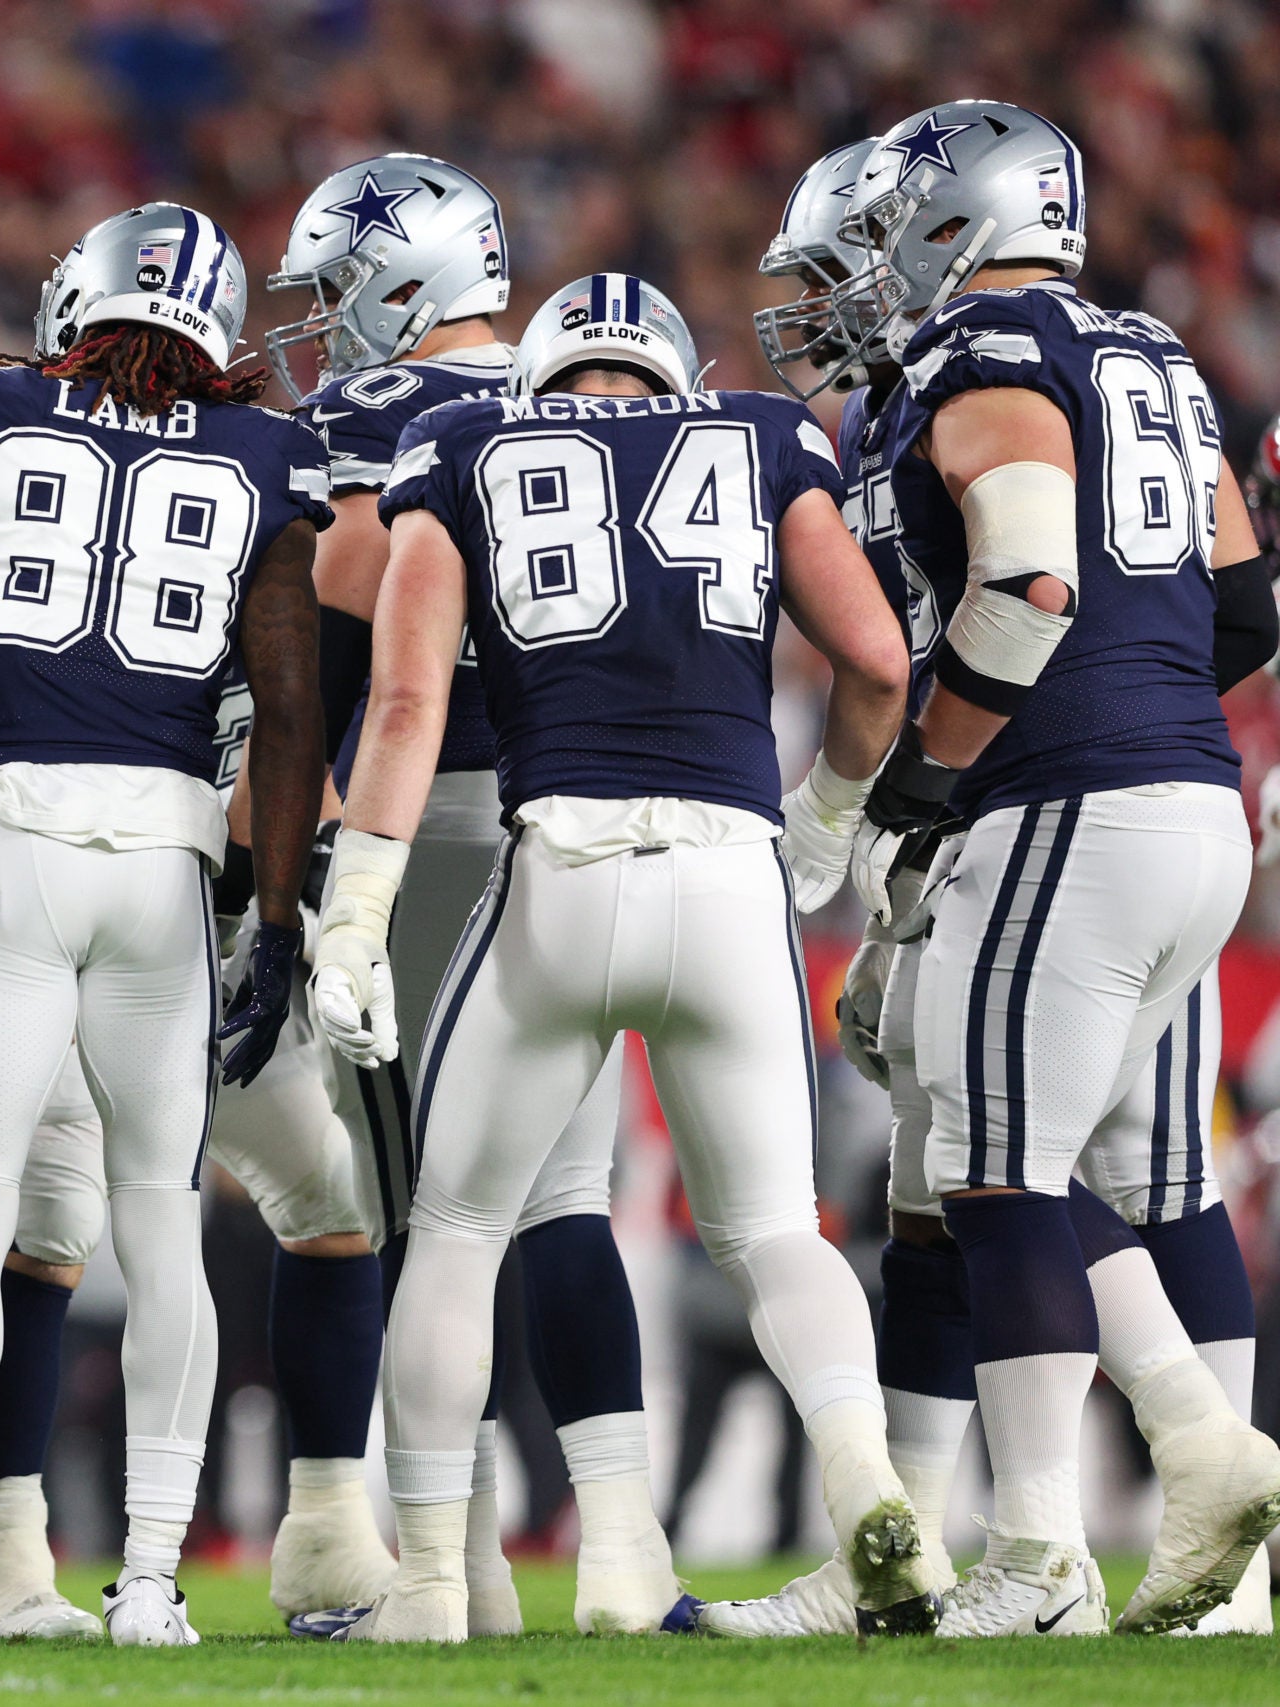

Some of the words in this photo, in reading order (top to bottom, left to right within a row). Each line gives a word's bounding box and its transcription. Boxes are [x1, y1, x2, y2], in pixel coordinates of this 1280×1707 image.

[1043, 210, 1064, 222] MLK
[1061, 238, 1074, 252] BE
[138, 272, 164, 285] MLK
[173, 308, 209, 337] LOVE
[563, 311, 587, 327] MLK
[582, 327, 604, 340] BE
[608, 327, 649, 345] LOVE
[53, 379, 197, 439] LAMB
[1091, 346, 1222, 581] 66
[474, 420, 773, 651] 84
